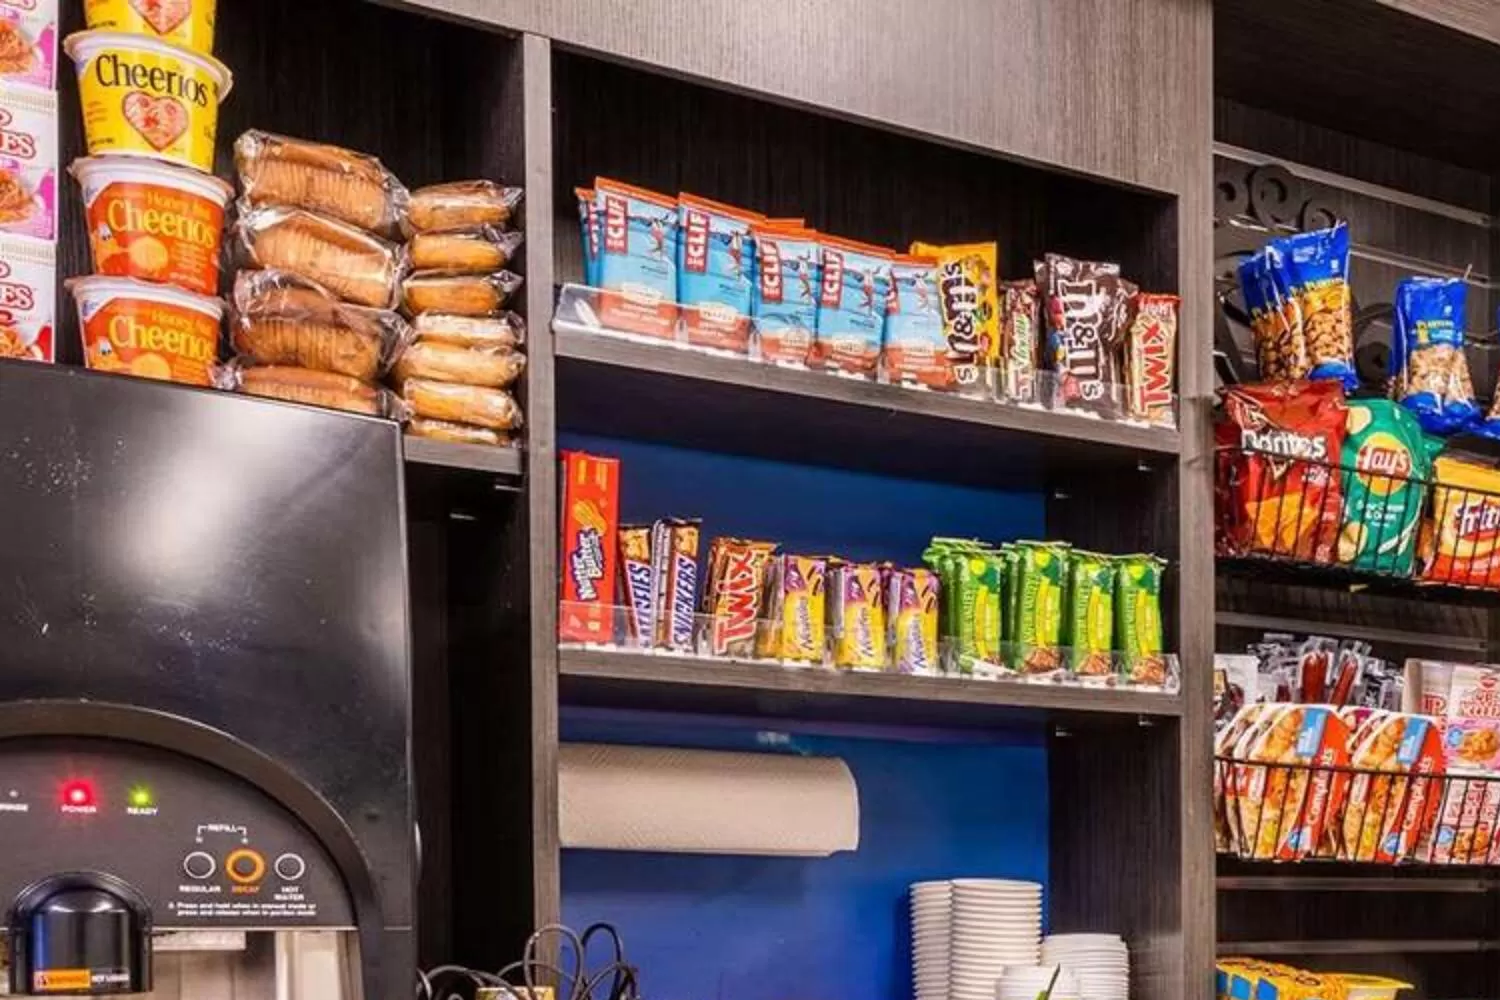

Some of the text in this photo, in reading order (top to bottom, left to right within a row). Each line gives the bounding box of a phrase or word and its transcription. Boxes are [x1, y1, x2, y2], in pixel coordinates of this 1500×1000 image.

[95, 54, 208, 107] Cheerios
[108, 199, 216, 249] Cheerios
[672, 557, 697, 647] SNICKERS
